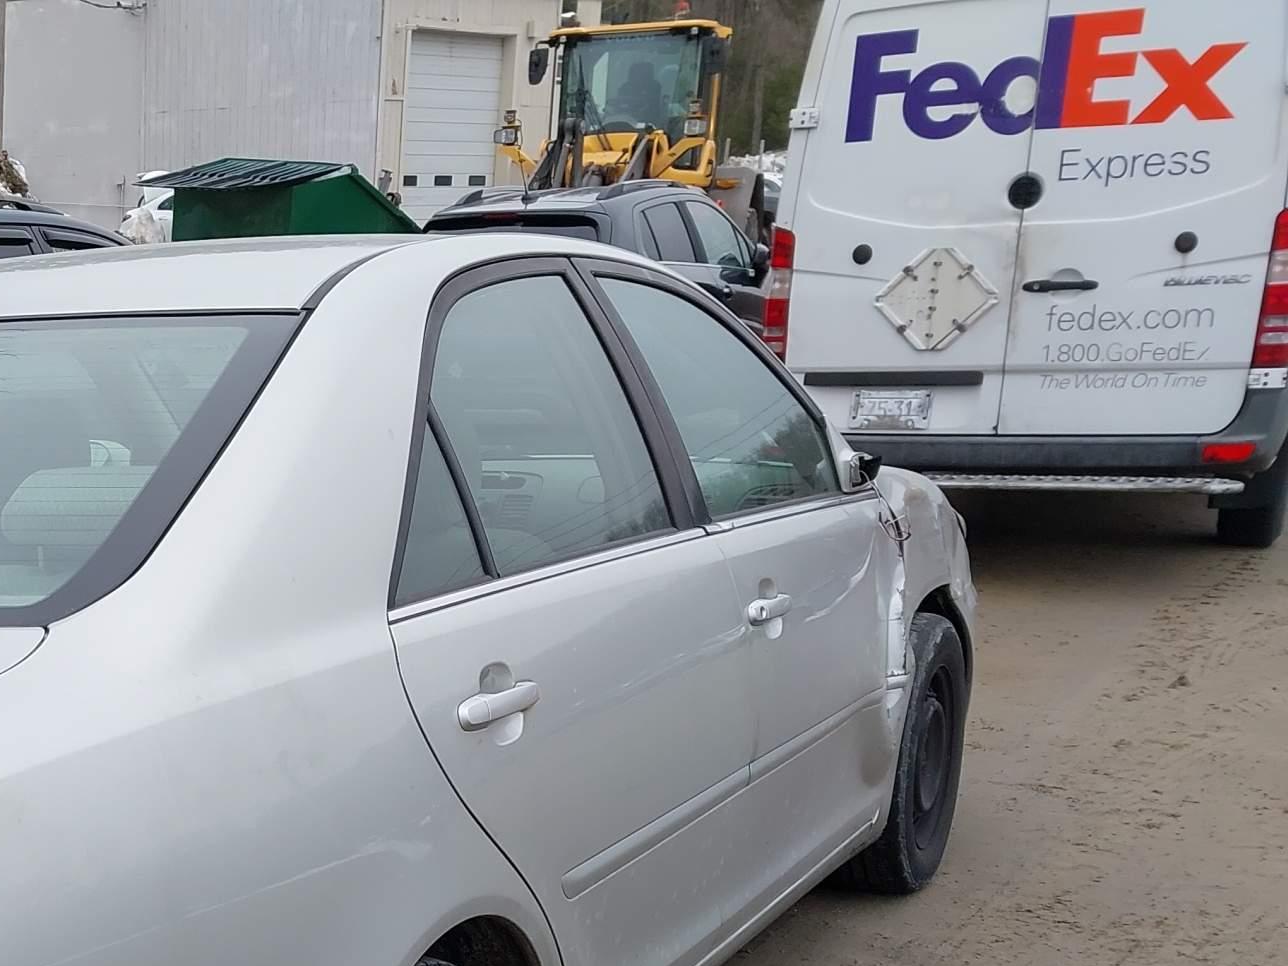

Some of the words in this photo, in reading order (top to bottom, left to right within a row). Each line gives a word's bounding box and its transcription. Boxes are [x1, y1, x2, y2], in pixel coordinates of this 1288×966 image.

[844, 8, 1250, 143] FedEx
[1058, 148, 1211, 187] Express
[1045, 304, 1215, 332] fedex.com
[1040, 374, 1070, 389] The
[1074, 373, 1127, 389] World
[1131, 372, 1158, 388] On
[1161, 372, 1208, 387] Time
